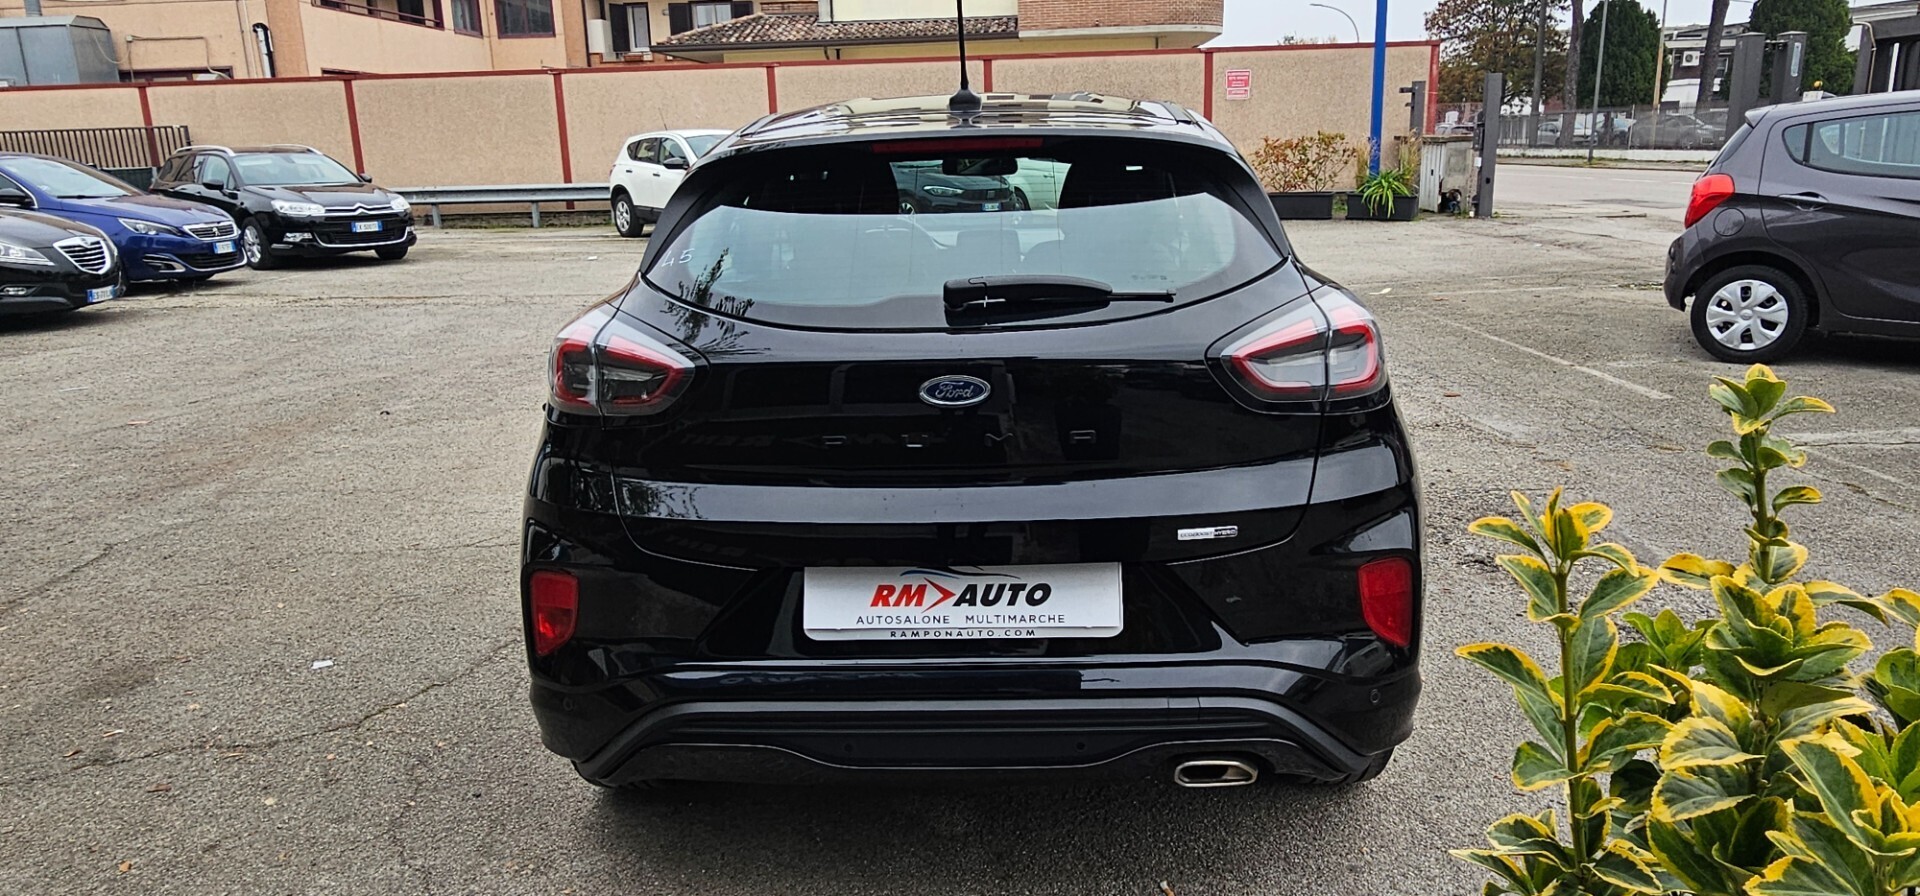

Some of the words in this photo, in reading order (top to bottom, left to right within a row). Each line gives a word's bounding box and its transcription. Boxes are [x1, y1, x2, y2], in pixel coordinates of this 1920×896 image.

[661, 247, 695, 267] 45
[934, 381, 974, 399] Ford
[870, 583, 927, 607] RM
[952, 582, 1053, 608] AUTO
[856, 615, 951, 625] AUTOSALONE
[965, 614, 1066, 624] MULTIMARCHE
[890, 629, 1037, 638] RAMPONAUTO.COM
